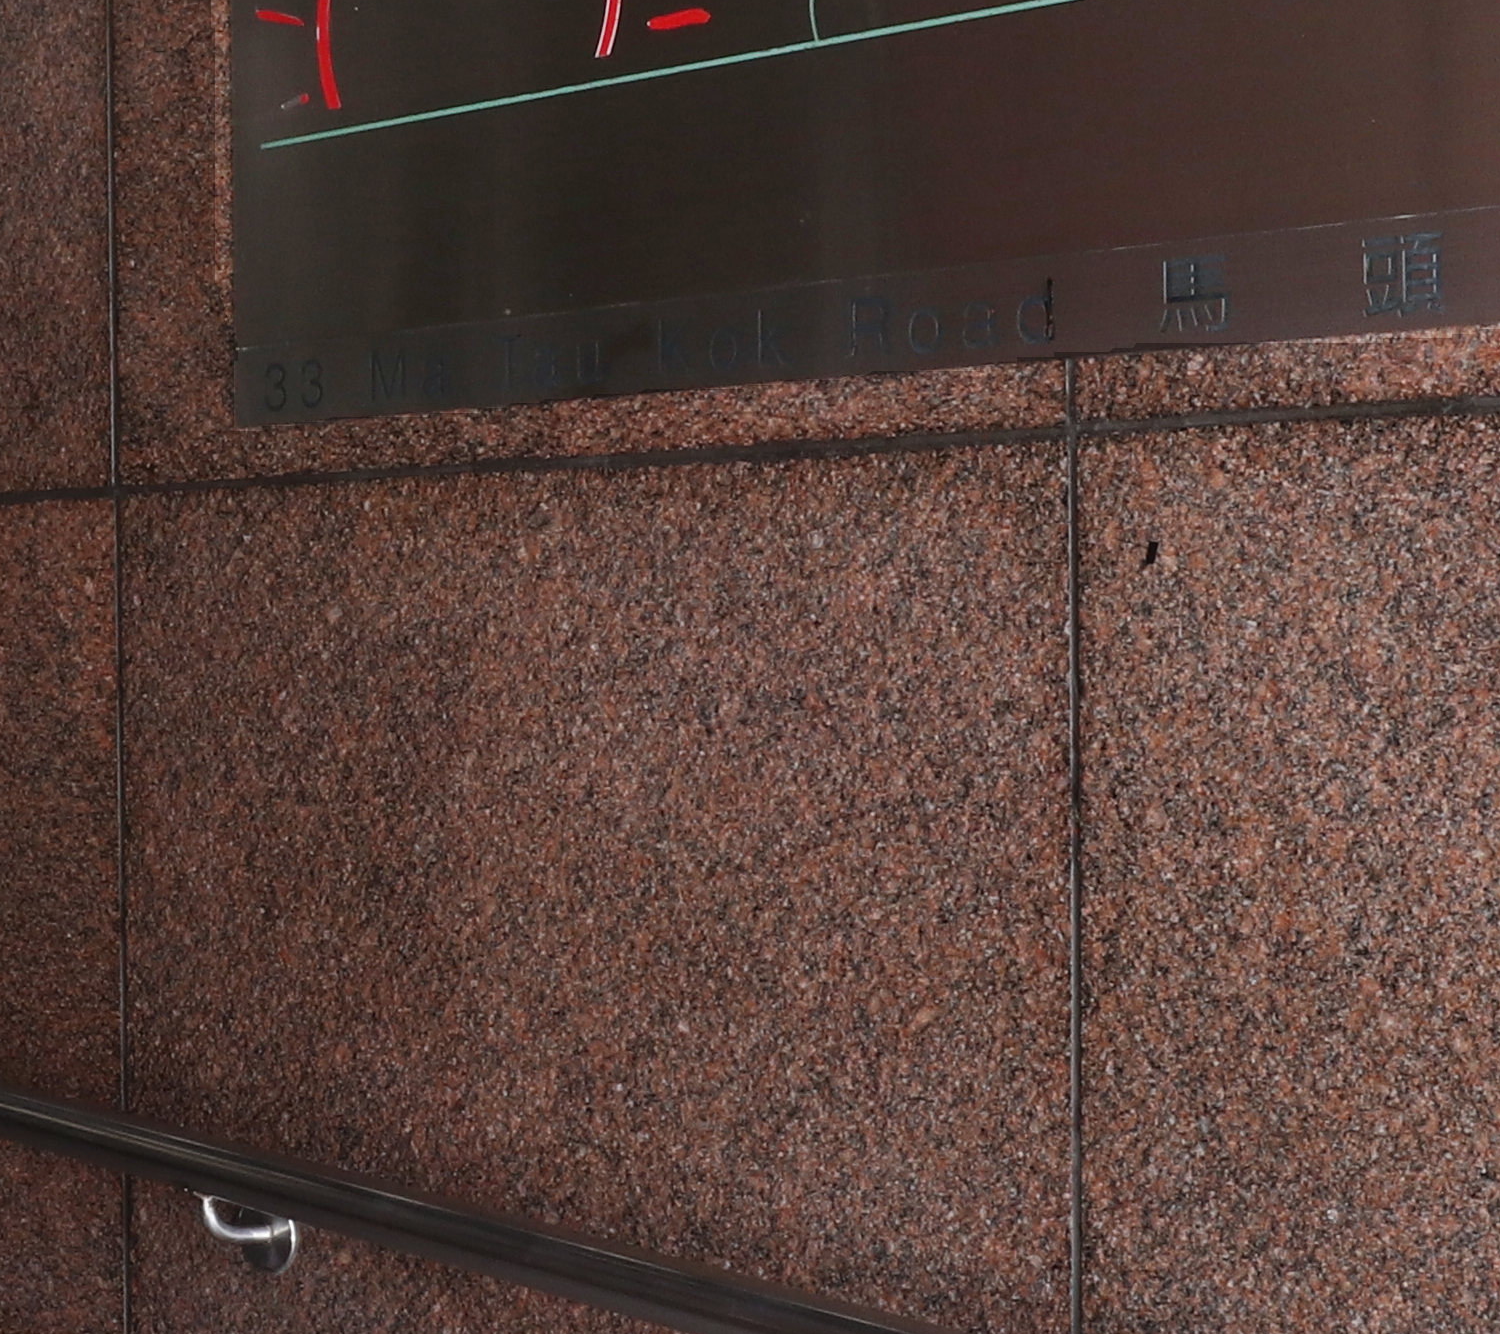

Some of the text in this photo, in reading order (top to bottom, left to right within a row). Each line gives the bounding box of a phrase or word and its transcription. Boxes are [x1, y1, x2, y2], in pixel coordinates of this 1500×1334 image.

[262, 275, 1057, 413] 33 Ma Tau Kok Road
